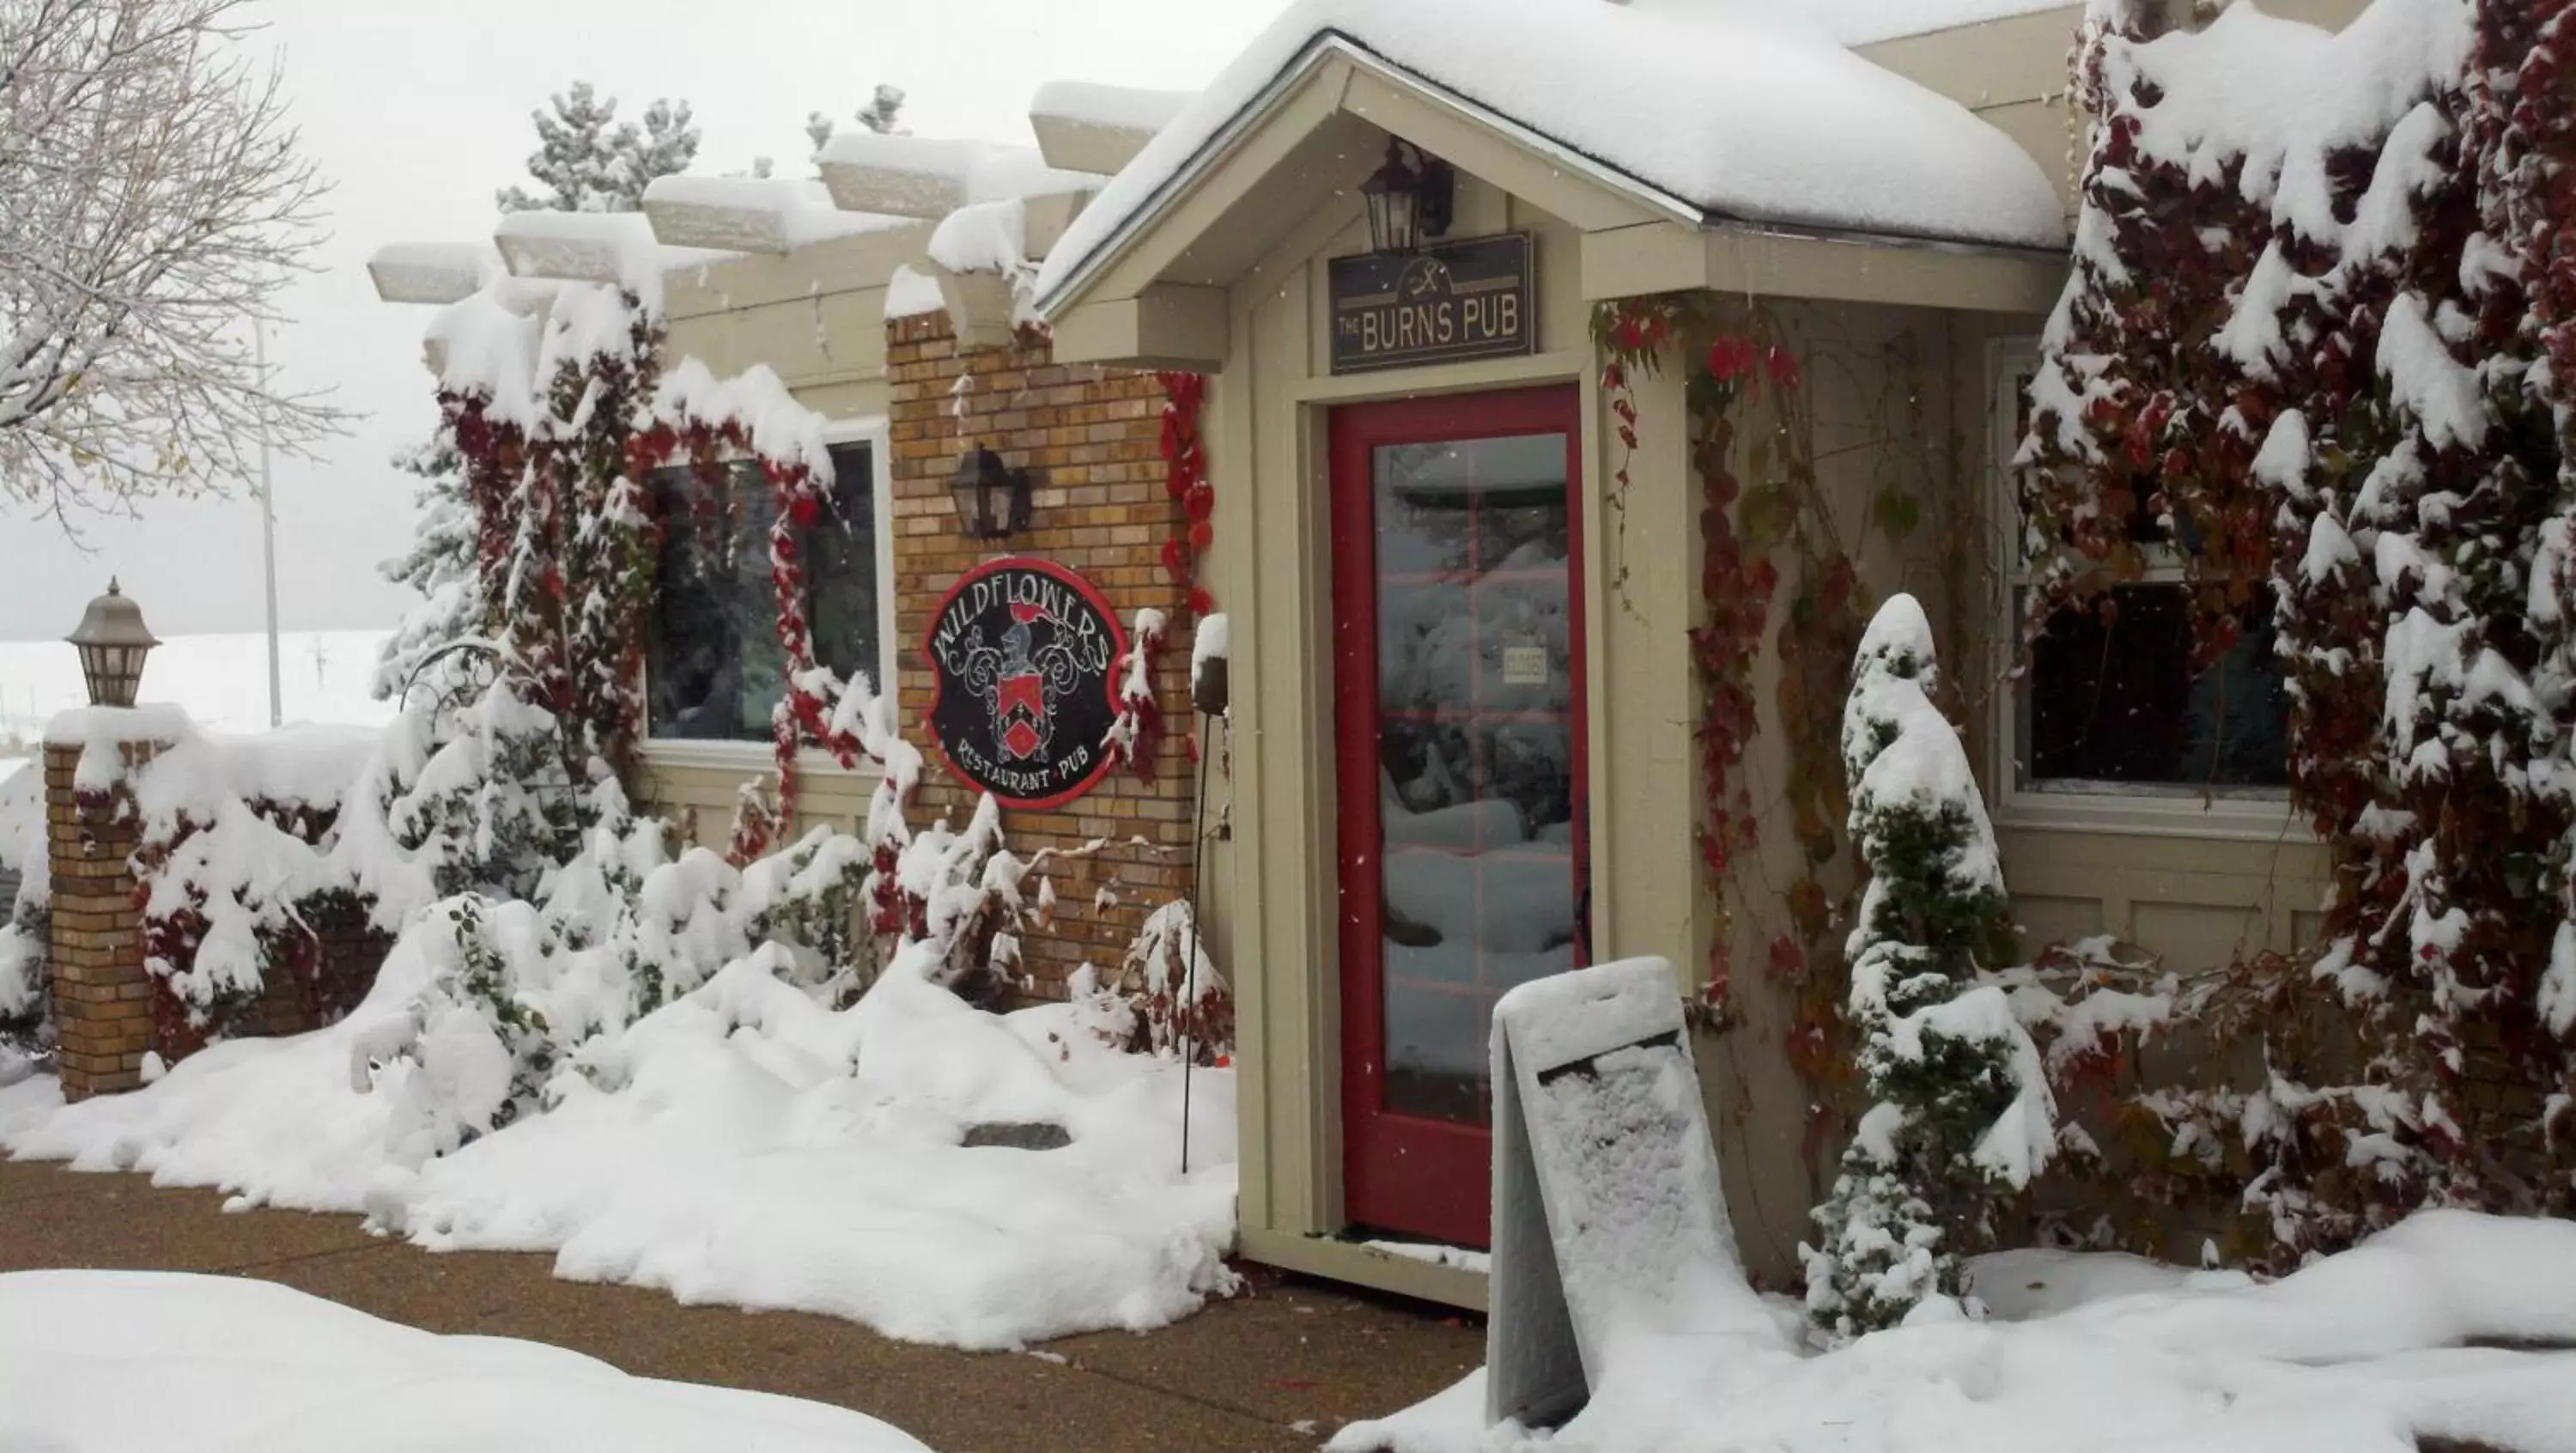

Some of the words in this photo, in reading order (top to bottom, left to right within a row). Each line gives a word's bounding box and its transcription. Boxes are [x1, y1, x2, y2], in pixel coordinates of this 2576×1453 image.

[1339, 316, 1359, 335] THE
[1363, 302, 1453, 351] BURNS
[1464, 294, 1518, 340] PUB
[934, 574, 1109, 676] WILDFLOWERS
[957, 738, 1051, 795] RESTAURANT
[1059, 745, 1089, 780] PUB
